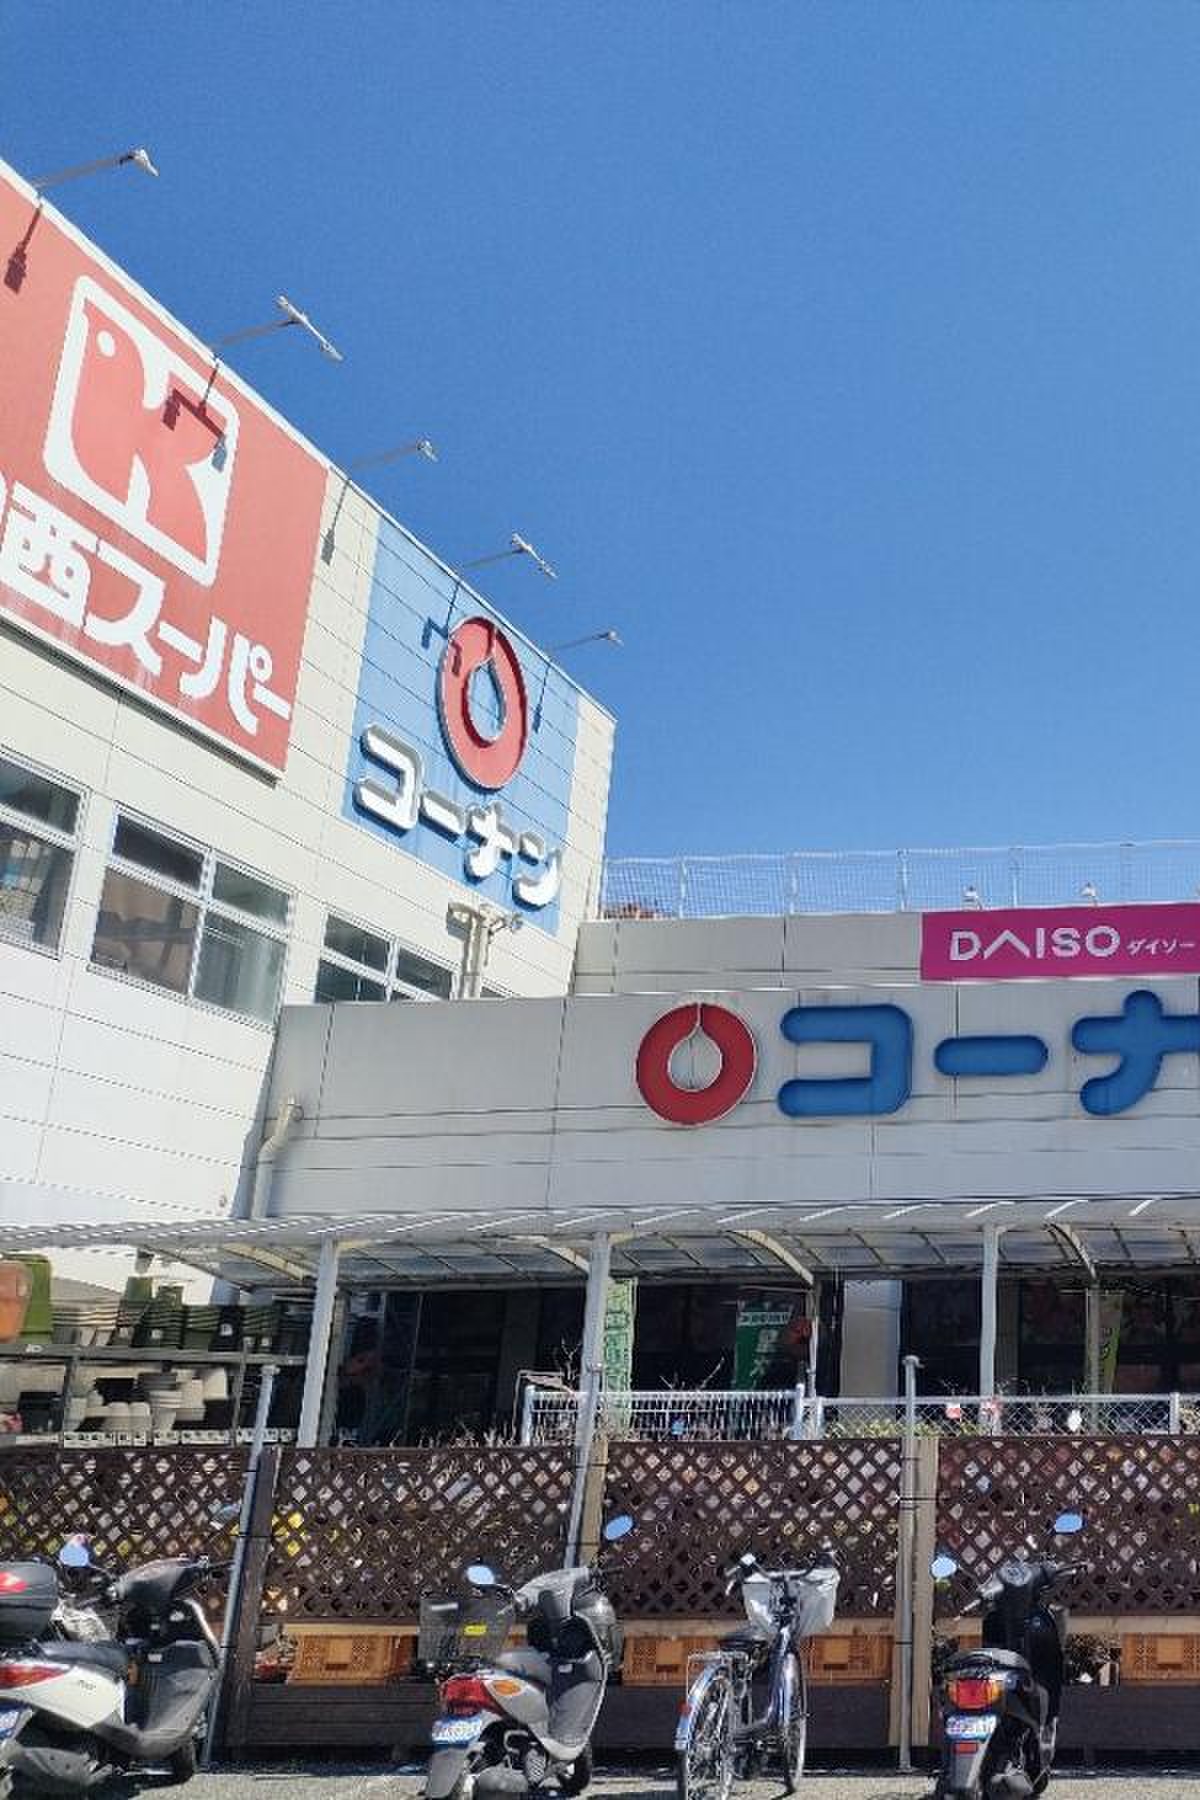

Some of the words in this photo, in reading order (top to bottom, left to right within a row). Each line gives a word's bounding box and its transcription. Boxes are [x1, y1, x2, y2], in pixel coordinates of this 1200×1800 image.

[0, 478, 291, 737] 西スーパー
[354, 724, 562, 909] コーナン
[950, 926, 1121, 961] DAISO
[1126, 937, 1196, 955] ダイソー
